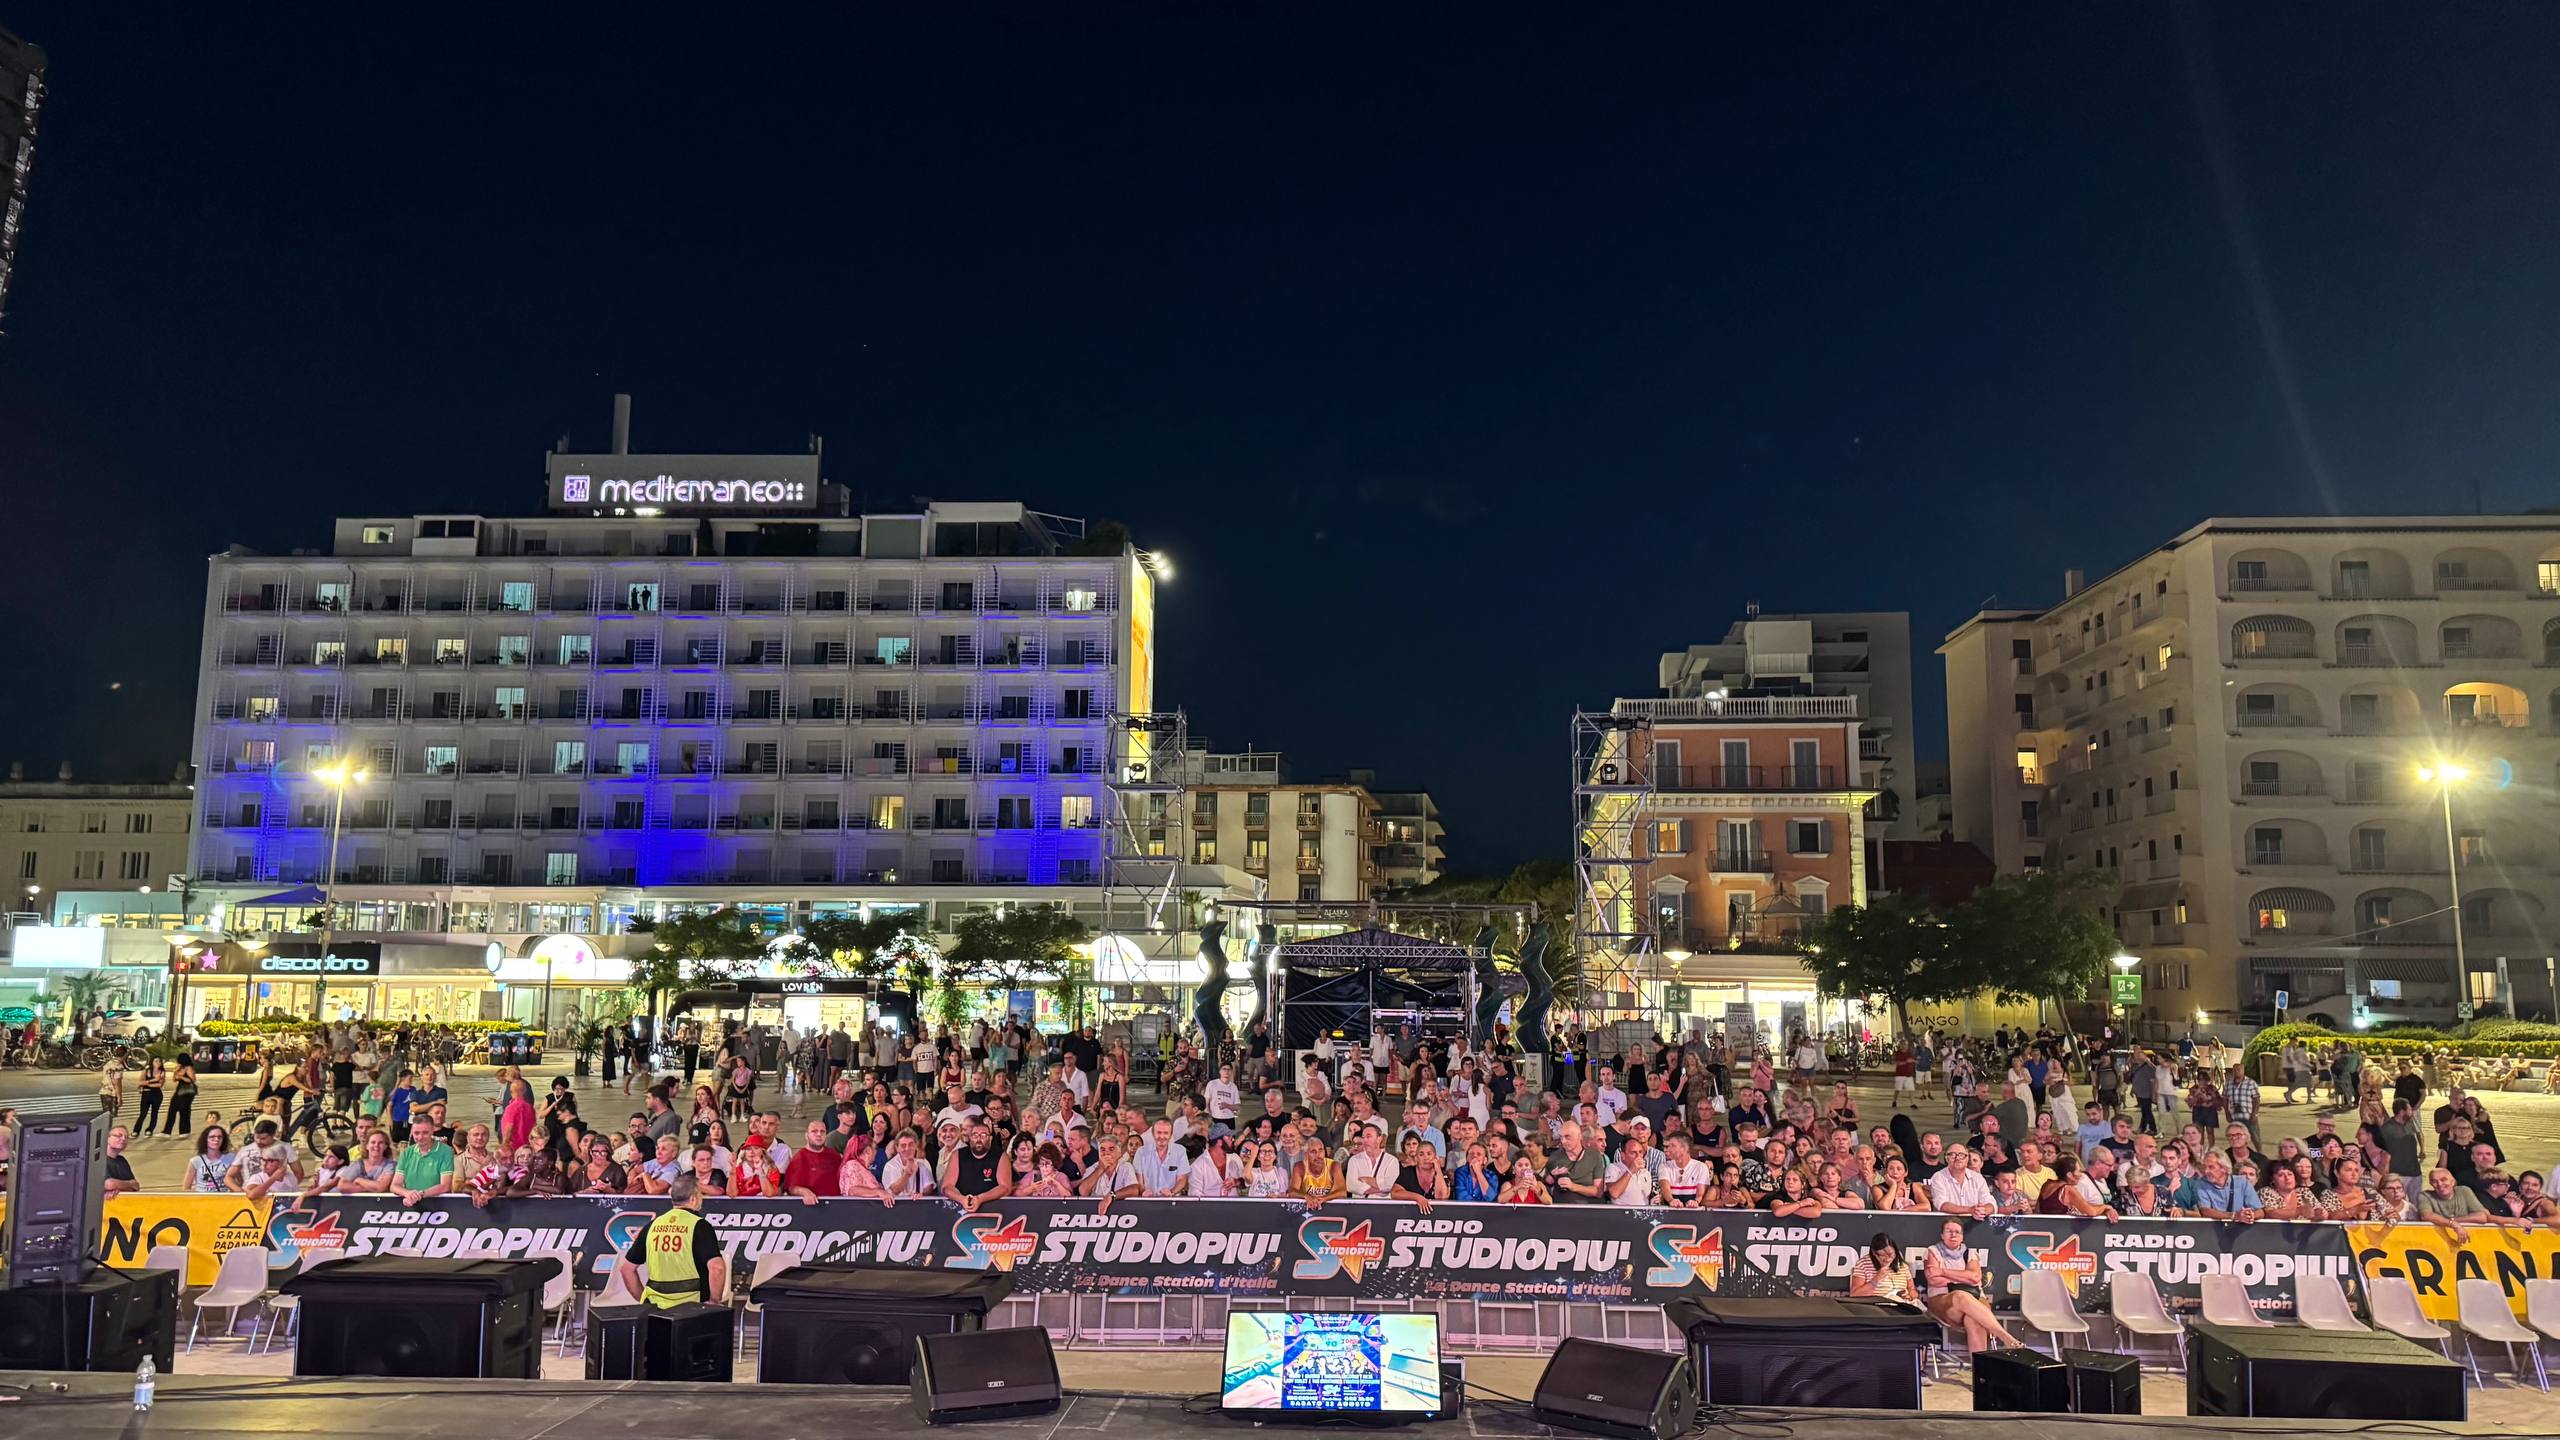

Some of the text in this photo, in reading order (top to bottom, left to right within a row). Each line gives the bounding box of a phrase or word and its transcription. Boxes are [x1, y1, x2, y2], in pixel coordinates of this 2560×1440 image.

[601, 475, 784, 502] mediterraneo
[360, 1211, 449, 1224] RADIO
[705, 1213, 792, 1227] RADIO
[1049, 1214, 1137, 1228] RADIO
[652, 1225, 688, 1233] ASSISTENZA
[1394, 1219, 1483, 1234] RADIO
[1747, 1226, 1837, 1241] RADIO
[217, 1231, 259, 1240] GRANA
[2104, 1234, 2195, 1249] RADIO
[653, 1235, 682, 1252] 189
[2359, 1248, 2560, 1298] GRAN
[1099, 1275, 1149, 1287] Dance
[1153, 1276, 1215, 1288] Station
[1450, 1280, 1500, 1293] Dance
[1505, 1282, 1567, 1295] Station
